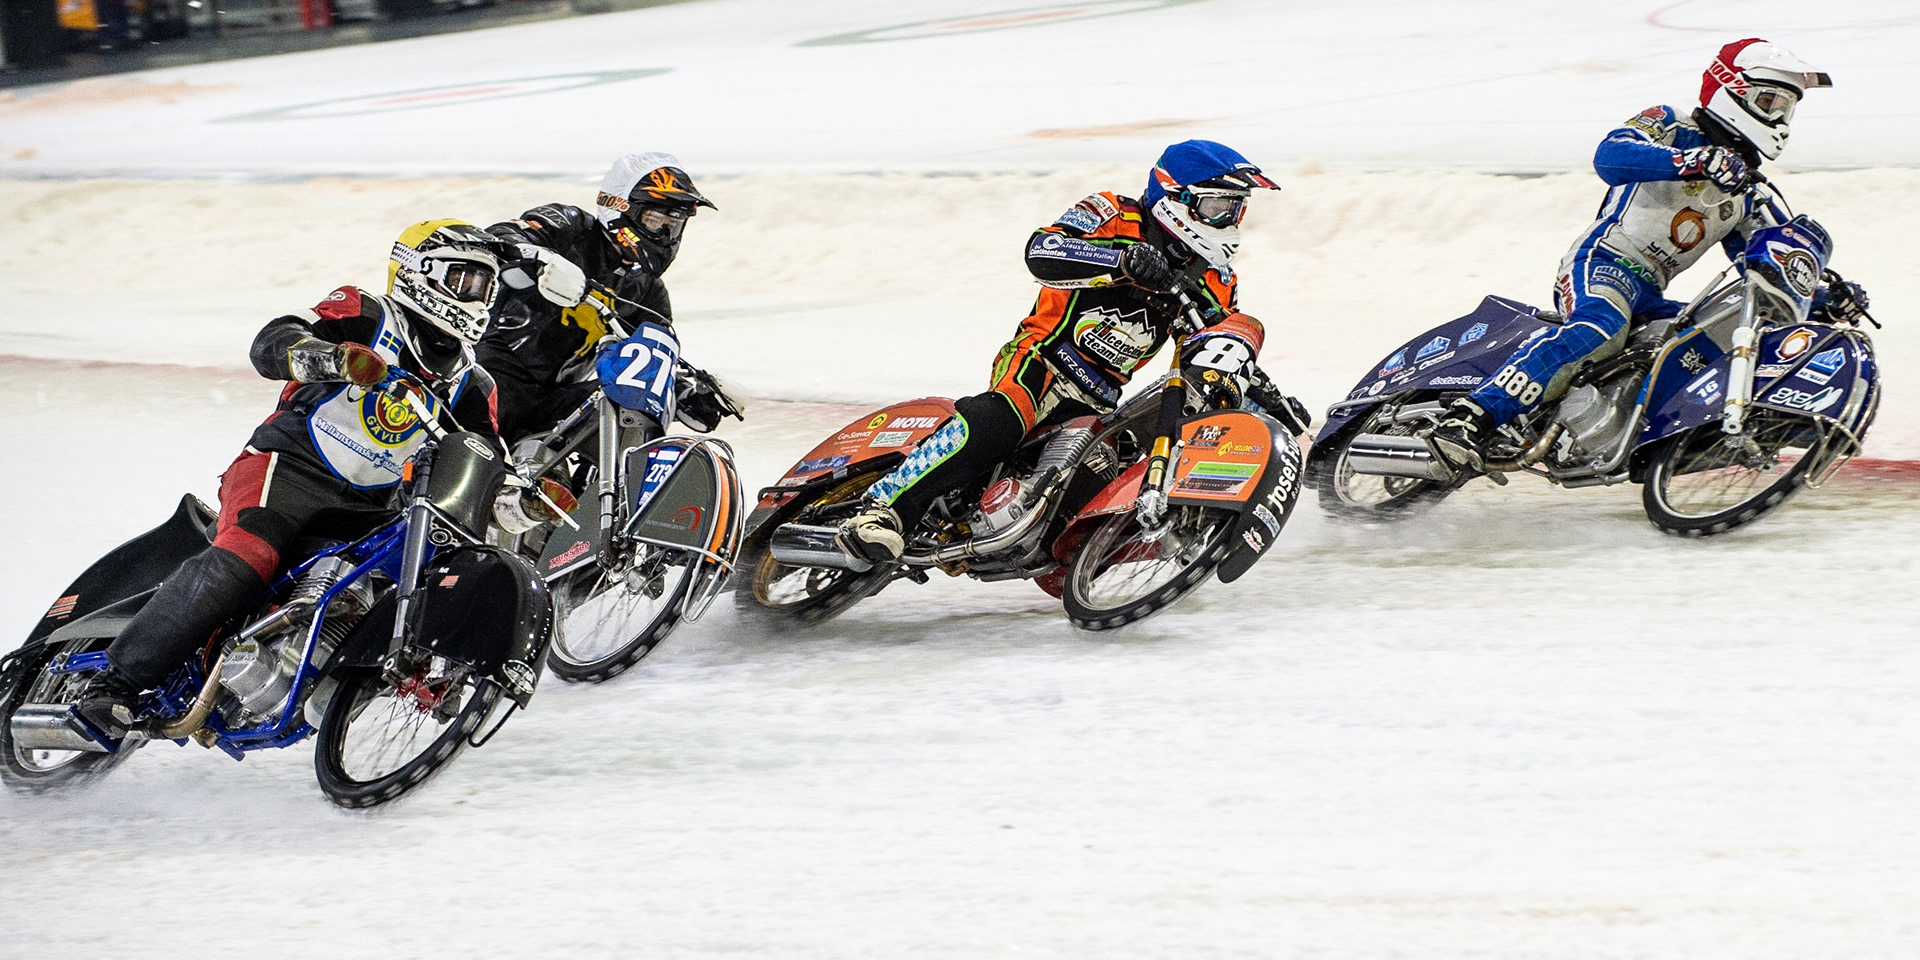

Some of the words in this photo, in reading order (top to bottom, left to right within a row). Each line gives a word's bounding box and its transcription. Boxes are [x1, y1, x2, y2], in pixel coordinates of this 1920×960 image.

[1709, 61, 1753, 97] 100%
[1160, 200, 1204, 240] SCOTT
[616, 342, 677, 397] 27
[1494, 364, 1543, 406] 888
[1696, 380, 1719, 398] 16
[315, 416, 376, 463] Mellansvenska
[366, 415, 402, 443] GÄVLE
[887, 416, 940, 429] MOTUL
[1267, 454, 1298, 515] Josef
